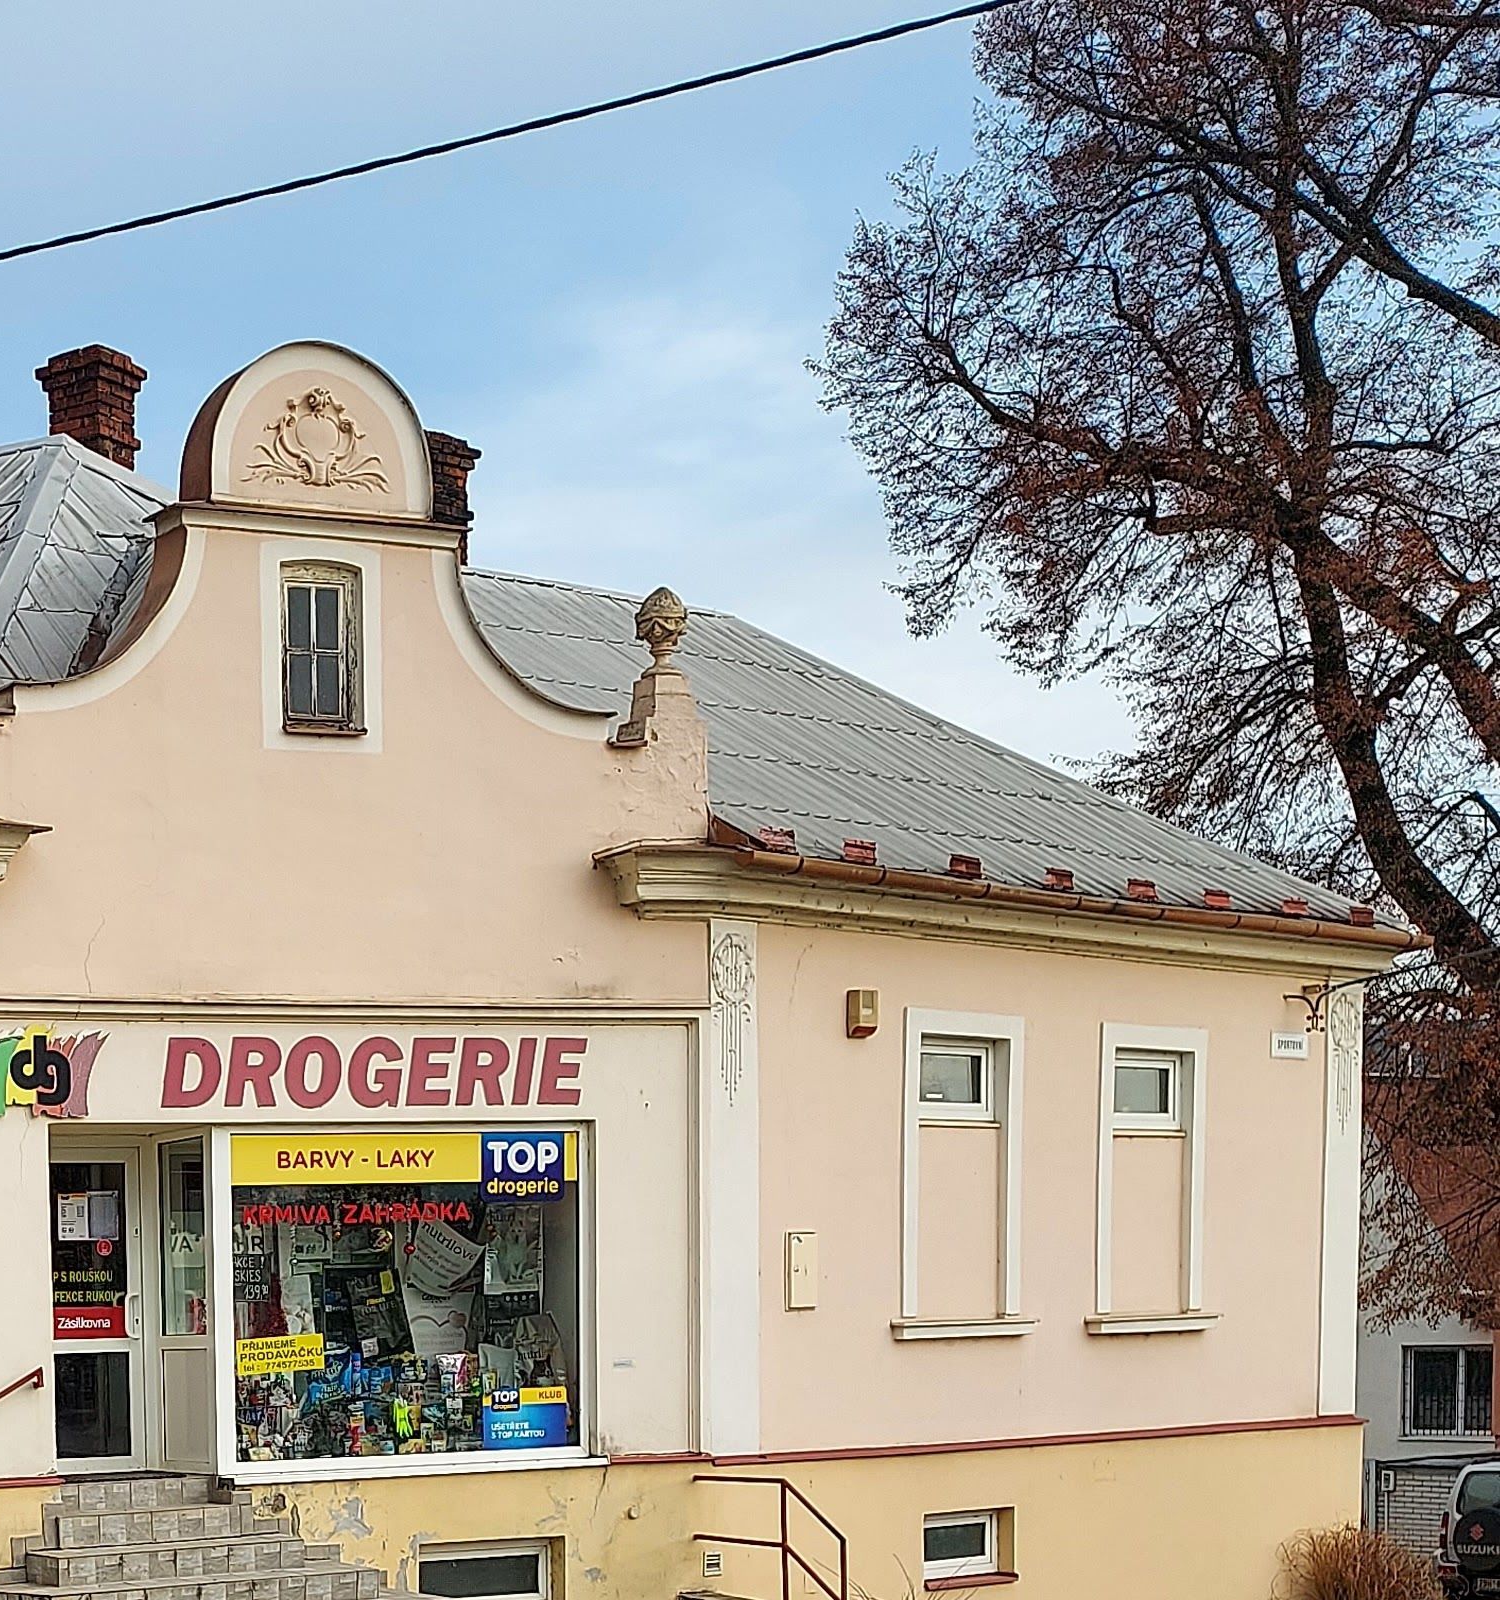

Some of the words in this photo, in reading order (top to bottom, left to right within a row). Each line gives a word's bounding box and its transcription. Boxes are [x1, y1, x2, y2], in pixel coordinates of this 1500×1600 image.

[1277, 1037, 1304, 1050] SPORTOVNÍ
[160, 1035, 589, 1109] DROGERIE
[277, 1150, 354, 1169] BARVY
[376, 1149, 434, 1168] LAKY
[486, 1140, 559, 1174] TOP
[486, 1177, 560, 1196] drogerie
[242, 1203, 330, 1225] KRMIVA
[69, 1267, 113, 1283] ROUŠKOU
[57, 1317, 111, 1329] Zásilkovna
[241, 1338, 297, 1352] PŘIJMEME
[239, 1346, 323, 1362] PRODAVAČKU
[492, 1390, 518, 1402] TOP
[538, 1389, 562, 1399] KLUB
[498, 1431, 512, 1439] TOP
